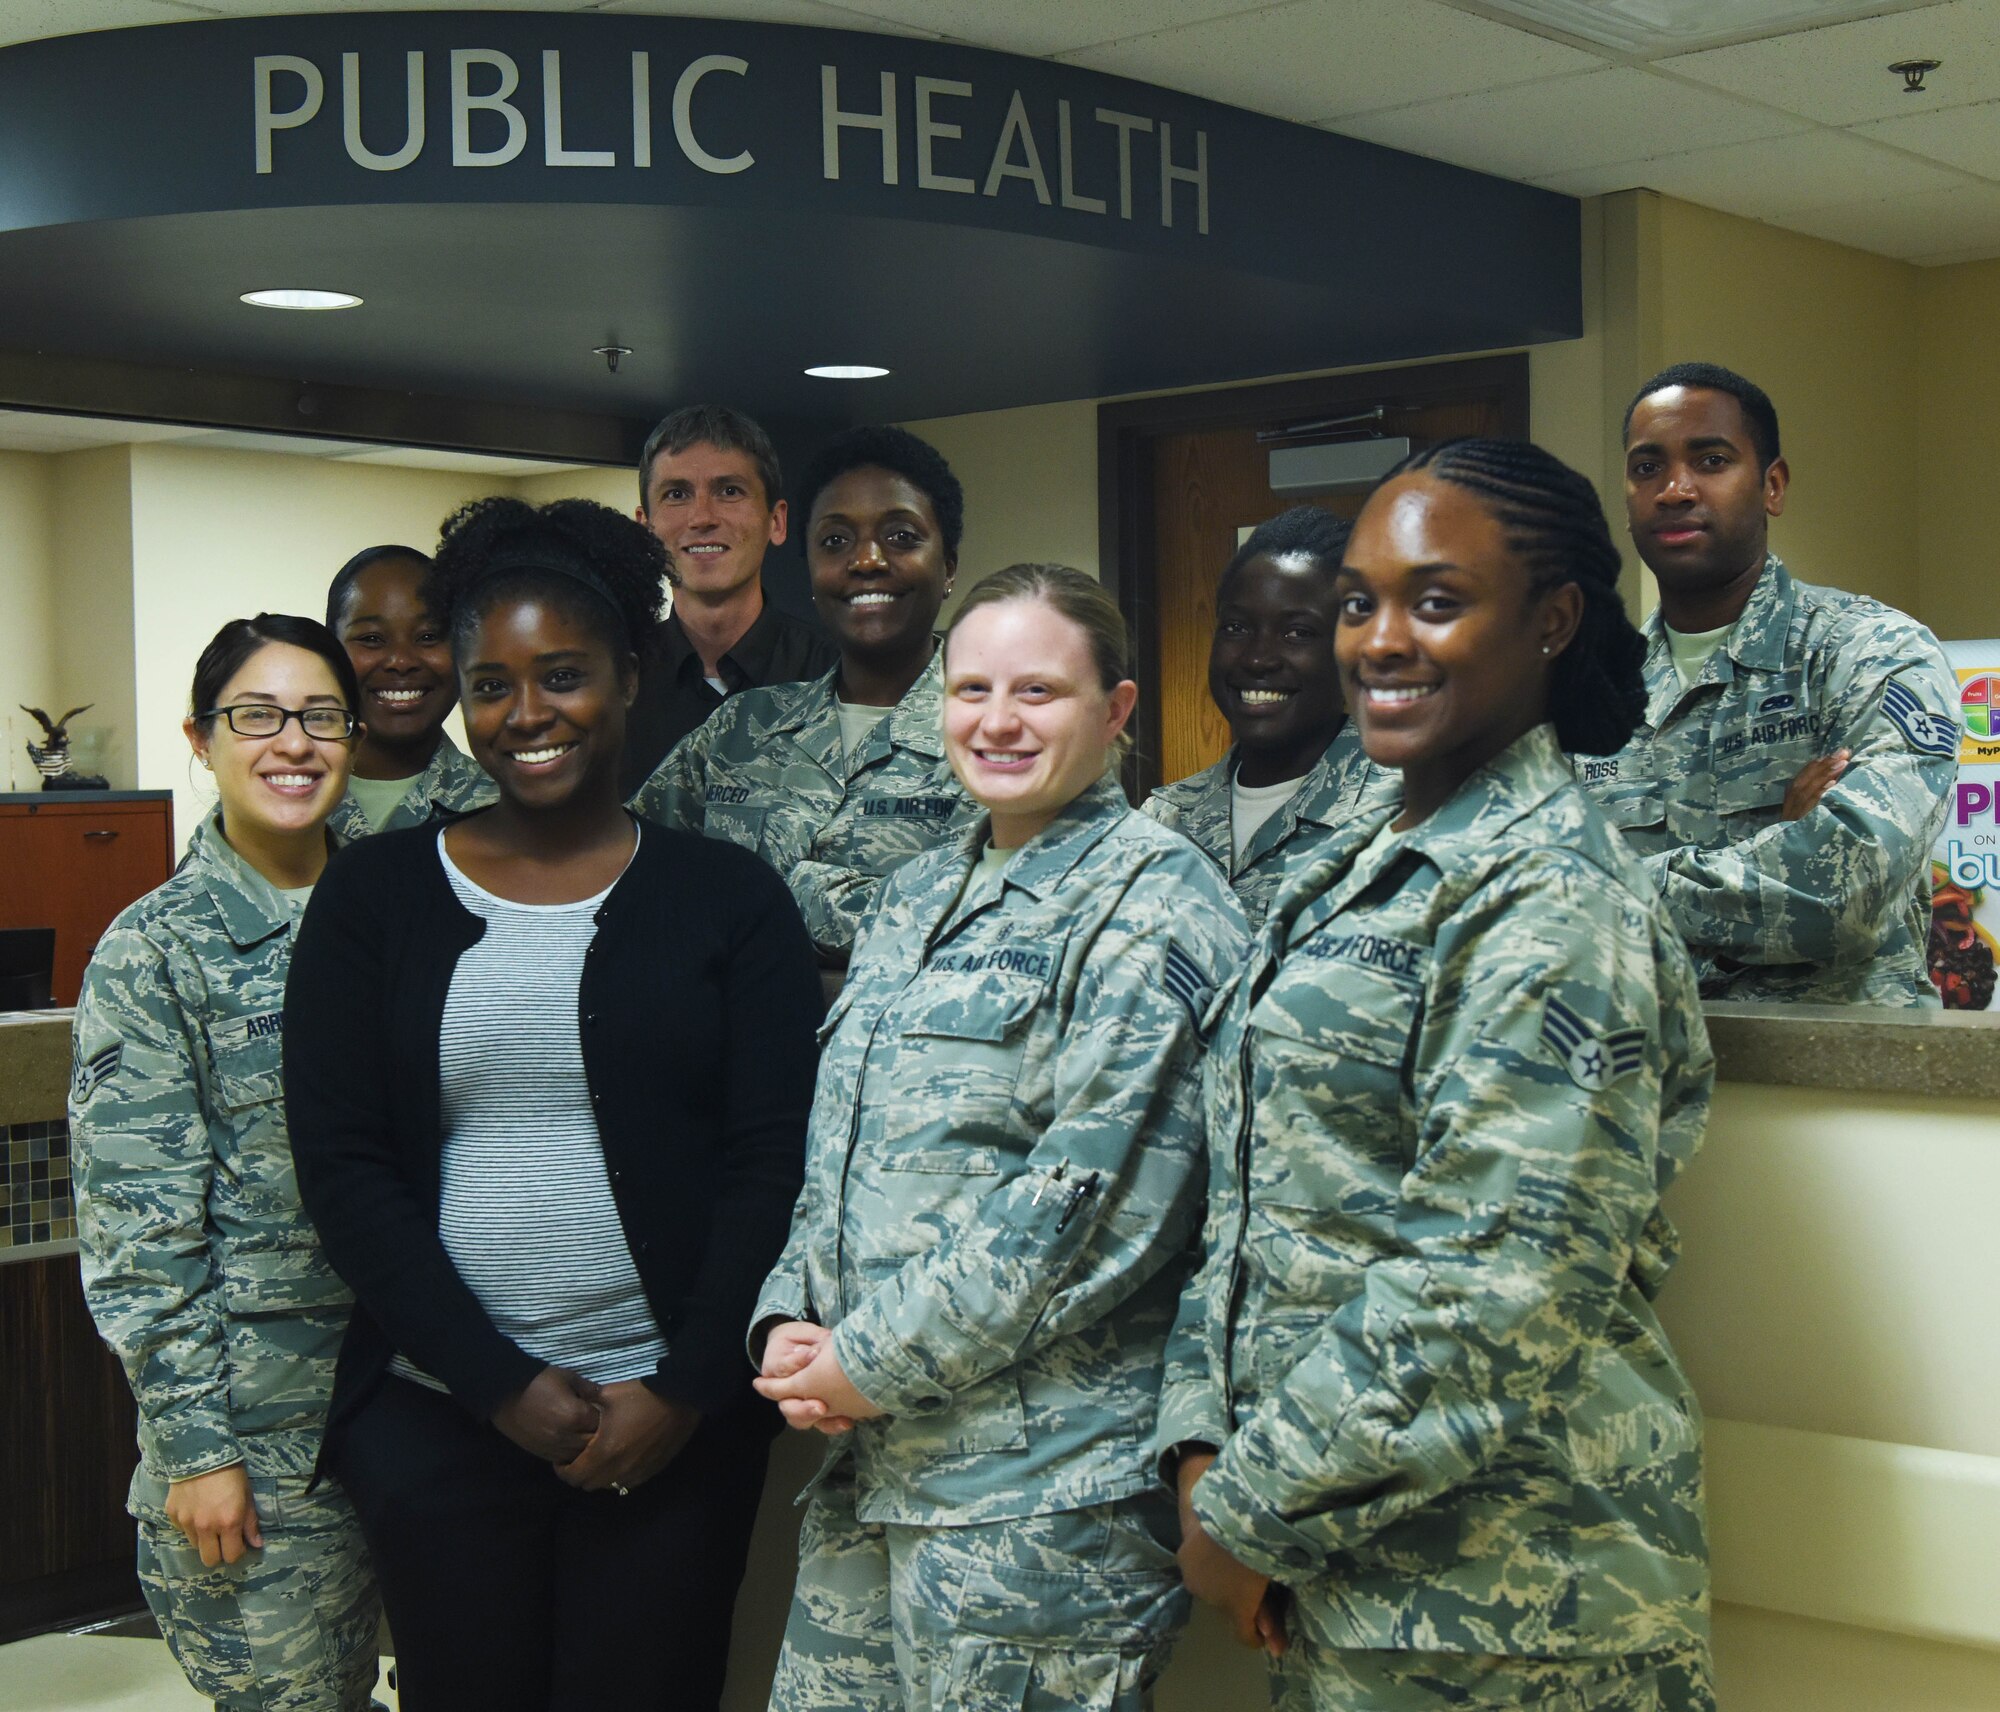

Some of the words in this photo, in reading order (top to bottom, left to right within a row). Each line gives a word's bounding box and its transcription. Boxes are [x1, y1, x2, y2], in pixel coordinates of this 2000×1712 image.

[253, 48, 756, 174] PUBLIC
[820, 64, 1210, 236] HEALTH
[1751, 724, 1777, 745] AIR
[1584, 760, 1619, 780] ROSS
[893, 798, 920, 815] AIR
[1974, 835, 1996, 846] ON
[987, 948, 1050, 977] FORCE
[1348, 934, 1423, 976] FORCE
